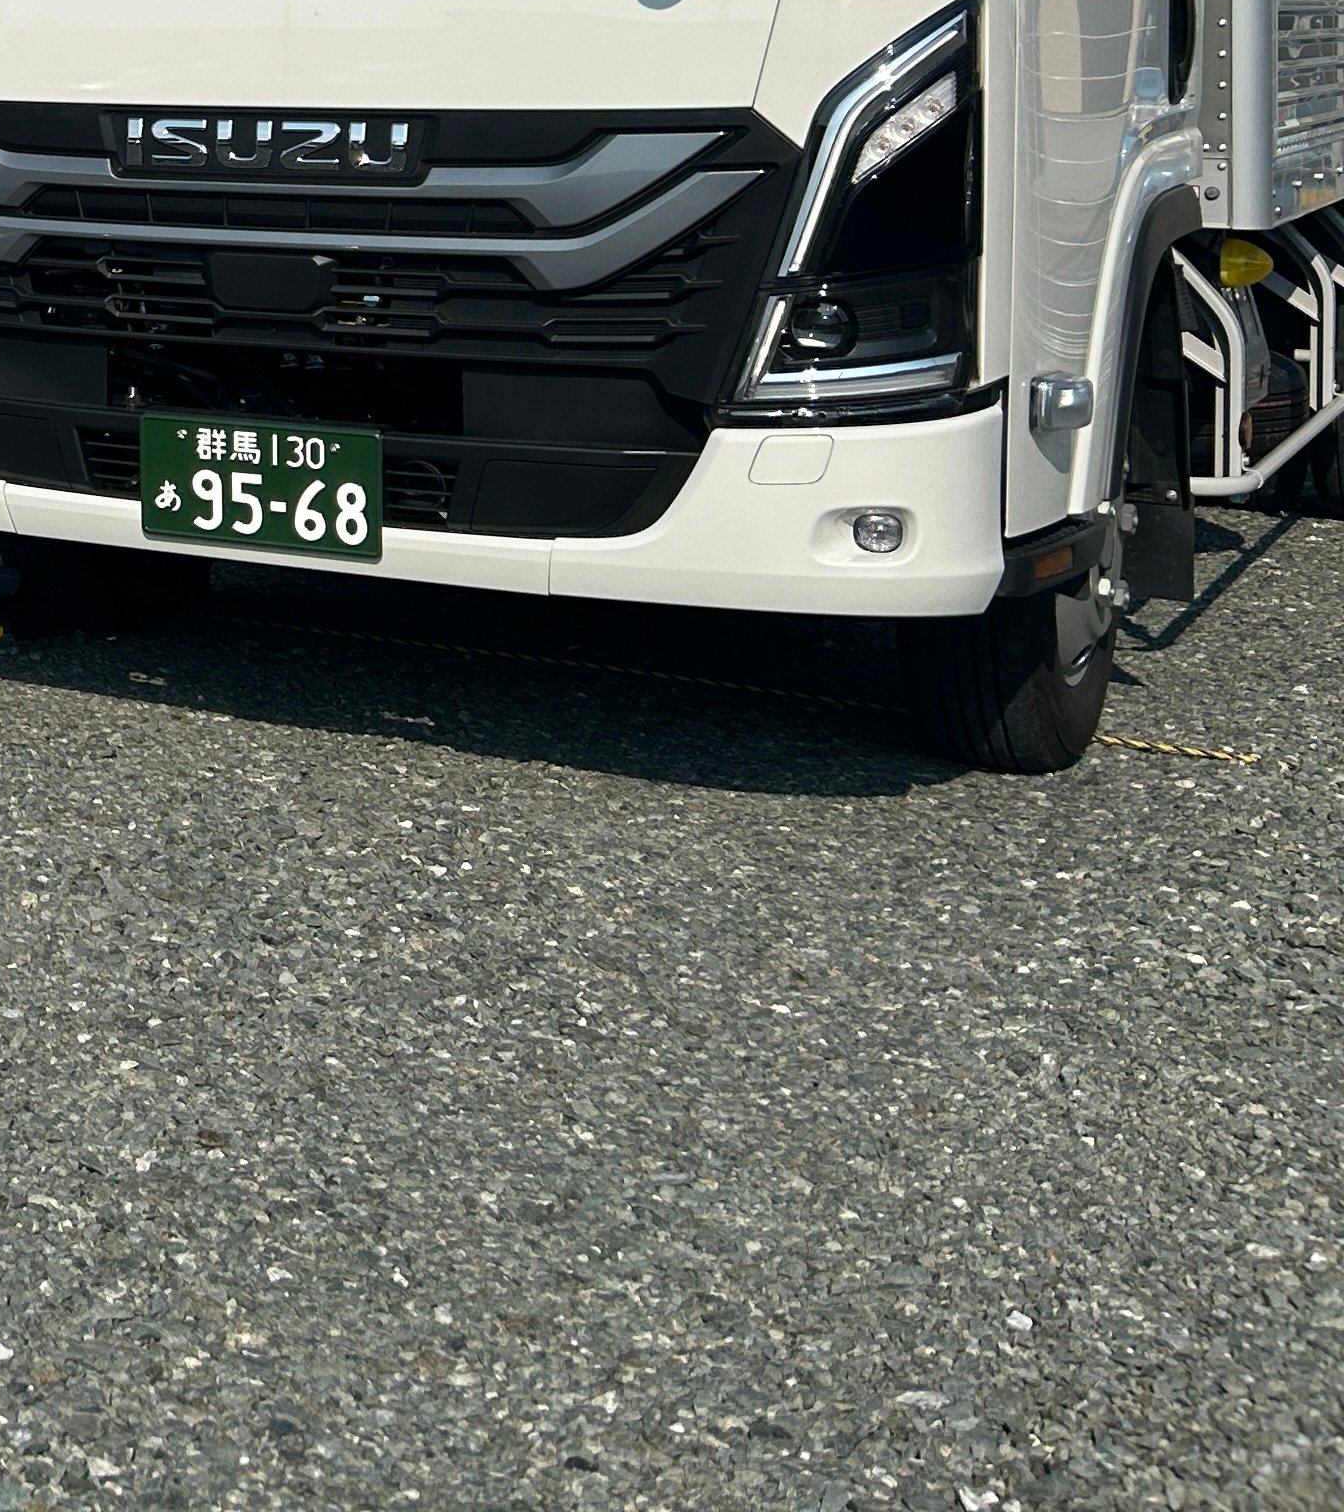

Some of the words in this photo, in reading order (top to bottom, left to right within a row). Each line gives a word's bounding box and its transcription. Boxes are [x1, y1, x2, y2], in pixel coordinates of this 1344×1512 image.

[126, 118, 409, 173] ISUZU
[154, 479, 182, 511] あ
[192, 469, 368, 546] 95-68
